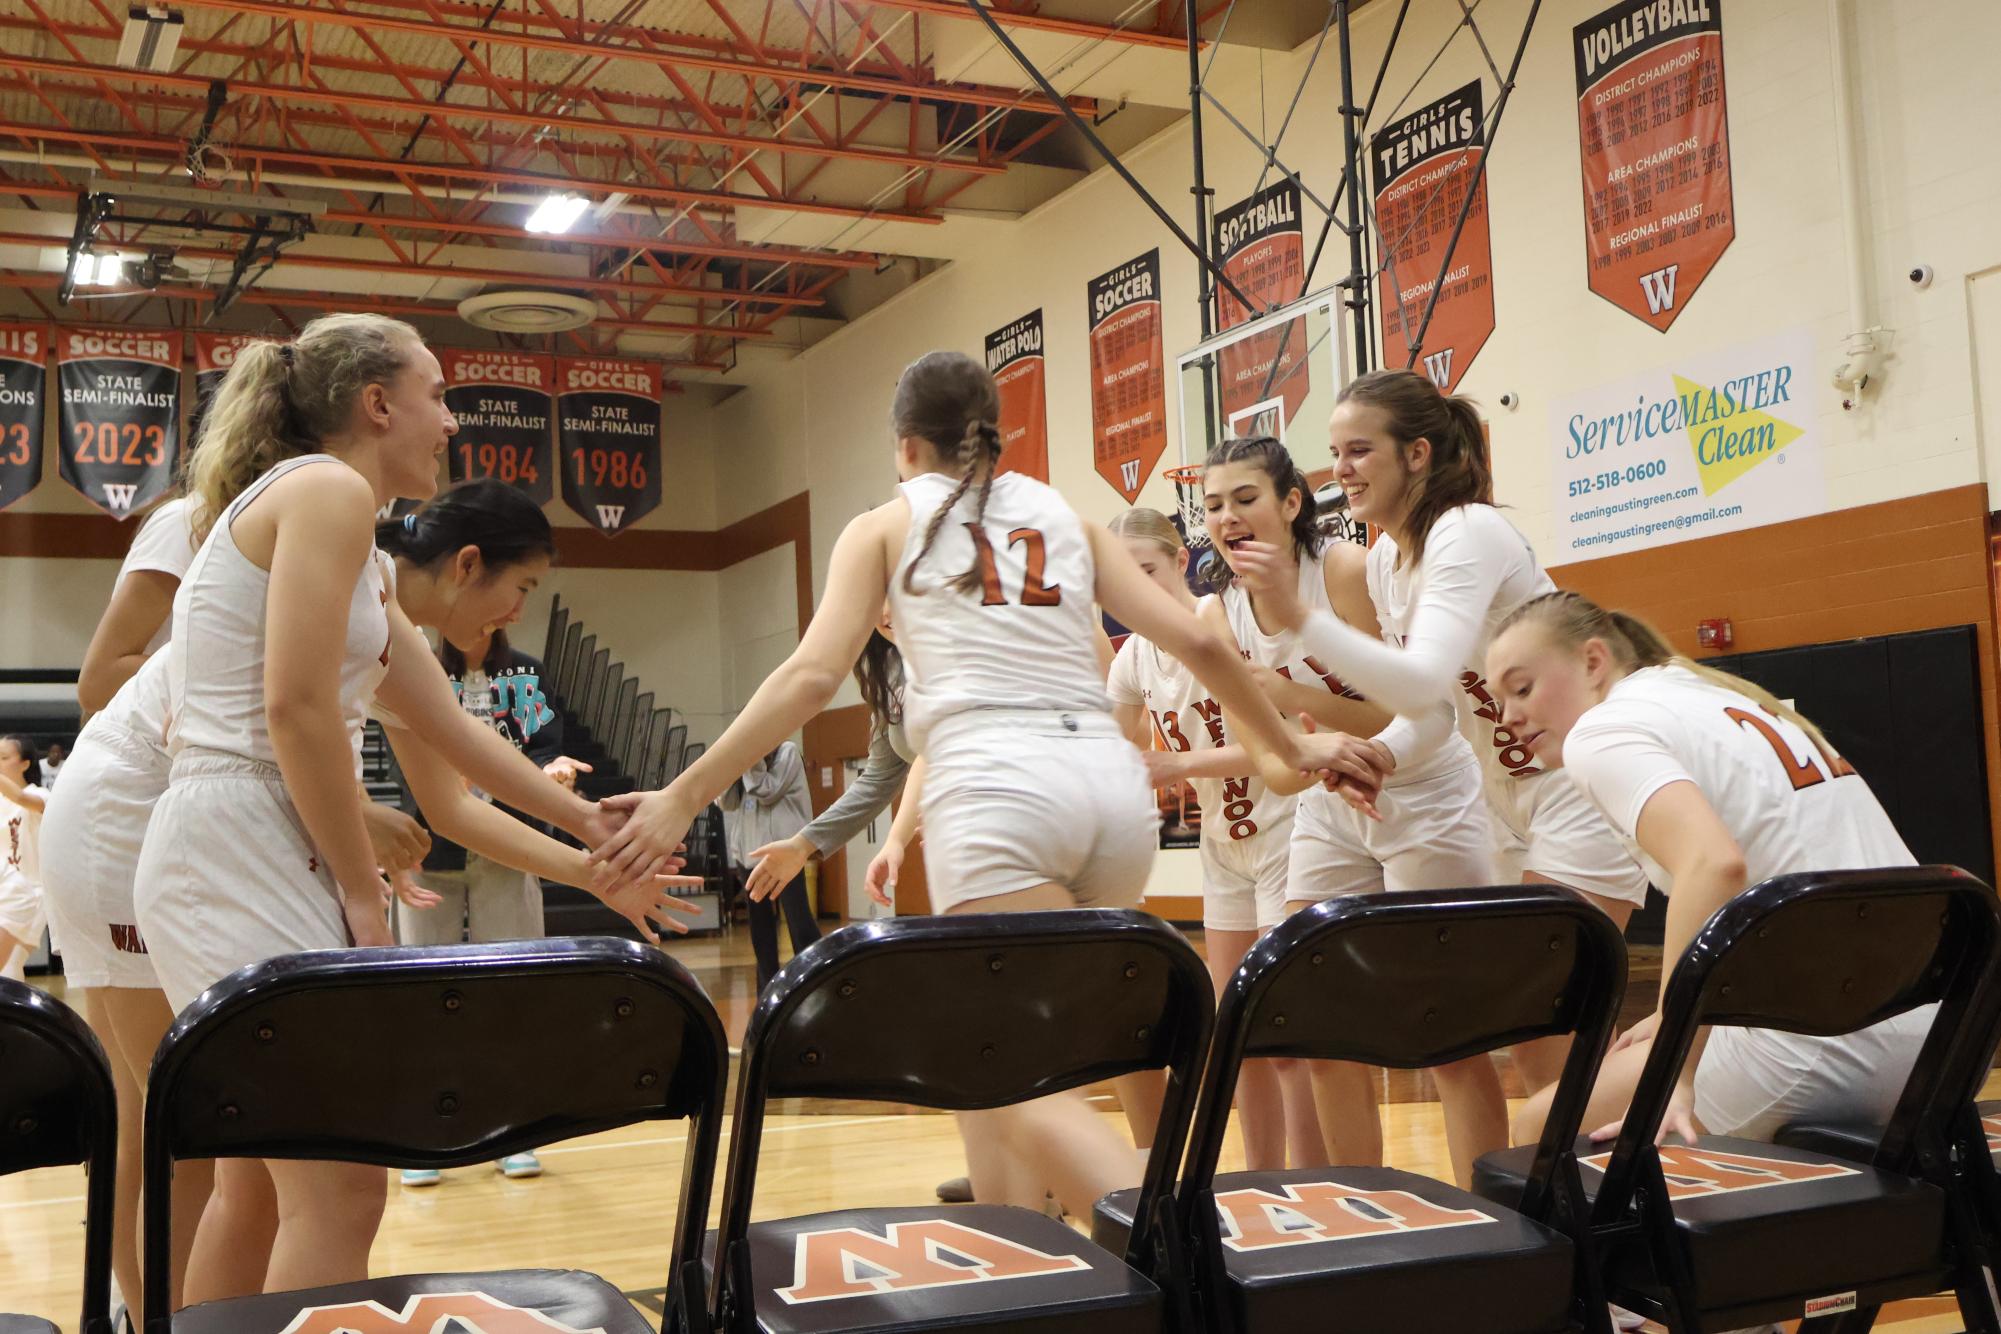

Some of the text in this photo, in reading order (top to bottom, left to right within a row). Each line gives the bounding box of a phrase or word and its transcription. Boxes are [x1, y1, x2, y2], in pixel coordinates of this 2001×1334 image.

[1583, 0, 1710, 77] VOLLEYBALL
[1595, 48, 1701, 105] DISTRICT CHAMPIONS
[1403, 103, 1445, 135] GIRLS
[1652, 111, 1671, 128] 2016
[1675, 100, 1694, 118] 2019
[1698, 89, 1719, 107] 2022
[1380, 107, 1473, 179] TENNIS
[1608, 136, 1698, 184] AREA CHAMPIONS
[1388, 178, 1418, 202] DISTRICT
[1420, 154, 1468, 187] CHAMPIONS
[1220, 190, 1295, 255] SOFTBALL
[1610, 203, 1704, 249] REGIONAL FINALIST
[1634, 201, 1652, 219] 2022
[1705, 211, 1726, 231] 2016
[1243, 245, 1273, 267] PLAYOFFS
[1109, 264, 1136, 286] GIRLS
[1442, 265, 1470, 286] NALIST
[1639, 264, 1679, 316] W
[1096, 271, 1153, 320] SOCCER
[1001, 321, 1024, 341] GIRLS
[69, 334, 170, 361] SOCCER
[477, 353, 519, 364] GIRLS
[987, 325, 1042, 372] WATER POLO
[454, 362, 542, 386] SOCCER
[589, 361, 630, 372] GIRLS
[1103, 374, 1118, 385] AREA
[1252, 353, 1291, 376] CHAMONS
[1423, 348, 1454, 389] W
[97, 374, 142, 390] STATE
[568, 369, 652, 393] SOCCER
[63, 389, 175, 408] SEMI-FINALIST
[479, 399, 518, 414] STATE
[591, 405, 629, 420] STATE
[1566, 365, 1792, 459] ServiceMASTER
[452, 412, 546, 430] SEMI-FINALIST
[564, 418, 655, 436] SEMI-FINALIST
[74, 421, 165, 466] 2023
[1698, 421, 1776, 466] Clean
[459, 443, 538, 484] 1984
[572, 447, 648, 489] 1986
[1120, 458, 1141, 492] W
[1568, 459, 1666, 497] 512-518-0600
[102, 483, 138, 510] W
[1570, 485, 1698, 523] cleaningaustingreen.com
[596, 505, 625, 529] W
[1572, 504, 1742, 549] cleaningaustingreen@gmail.com
[962, 522, 1061, 606] 12
[109, 923, 148, 954] WA
